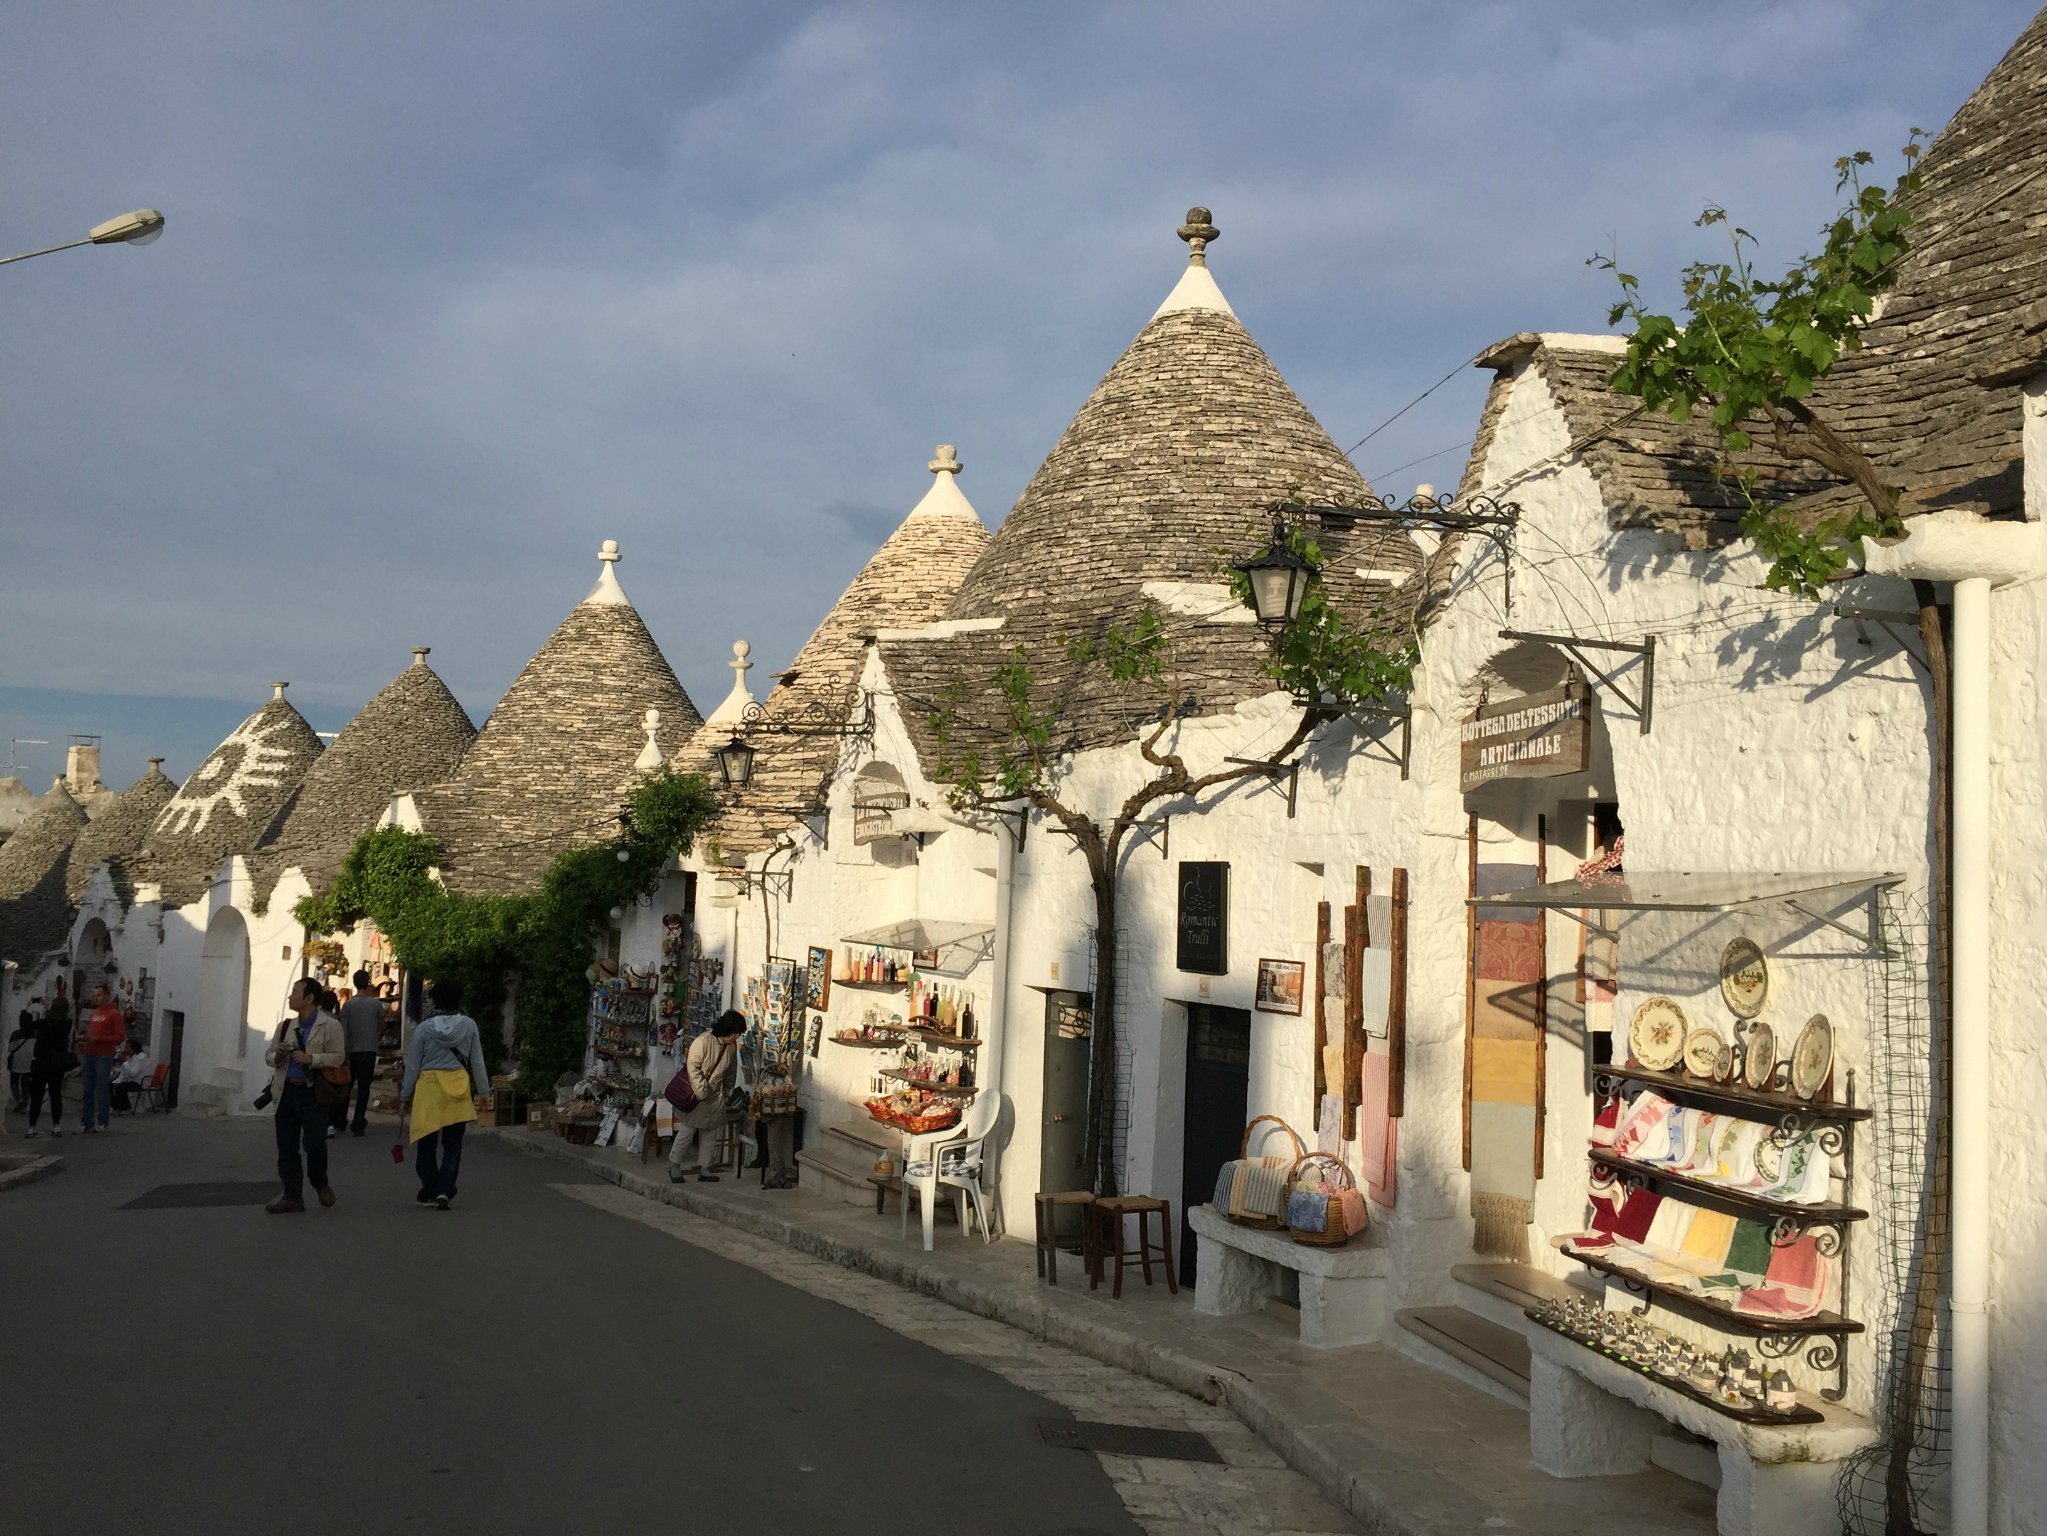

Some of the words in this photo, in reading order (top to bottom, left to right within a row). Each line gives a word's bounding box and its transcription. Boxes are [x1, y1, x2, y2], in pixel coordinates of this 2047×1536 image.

[1461, 716, 1506, 742] BOTTEGA
[1480, 735, 1561, 767] ARTIGIANALE
[1186, 929, 1210, 944] Trulli
